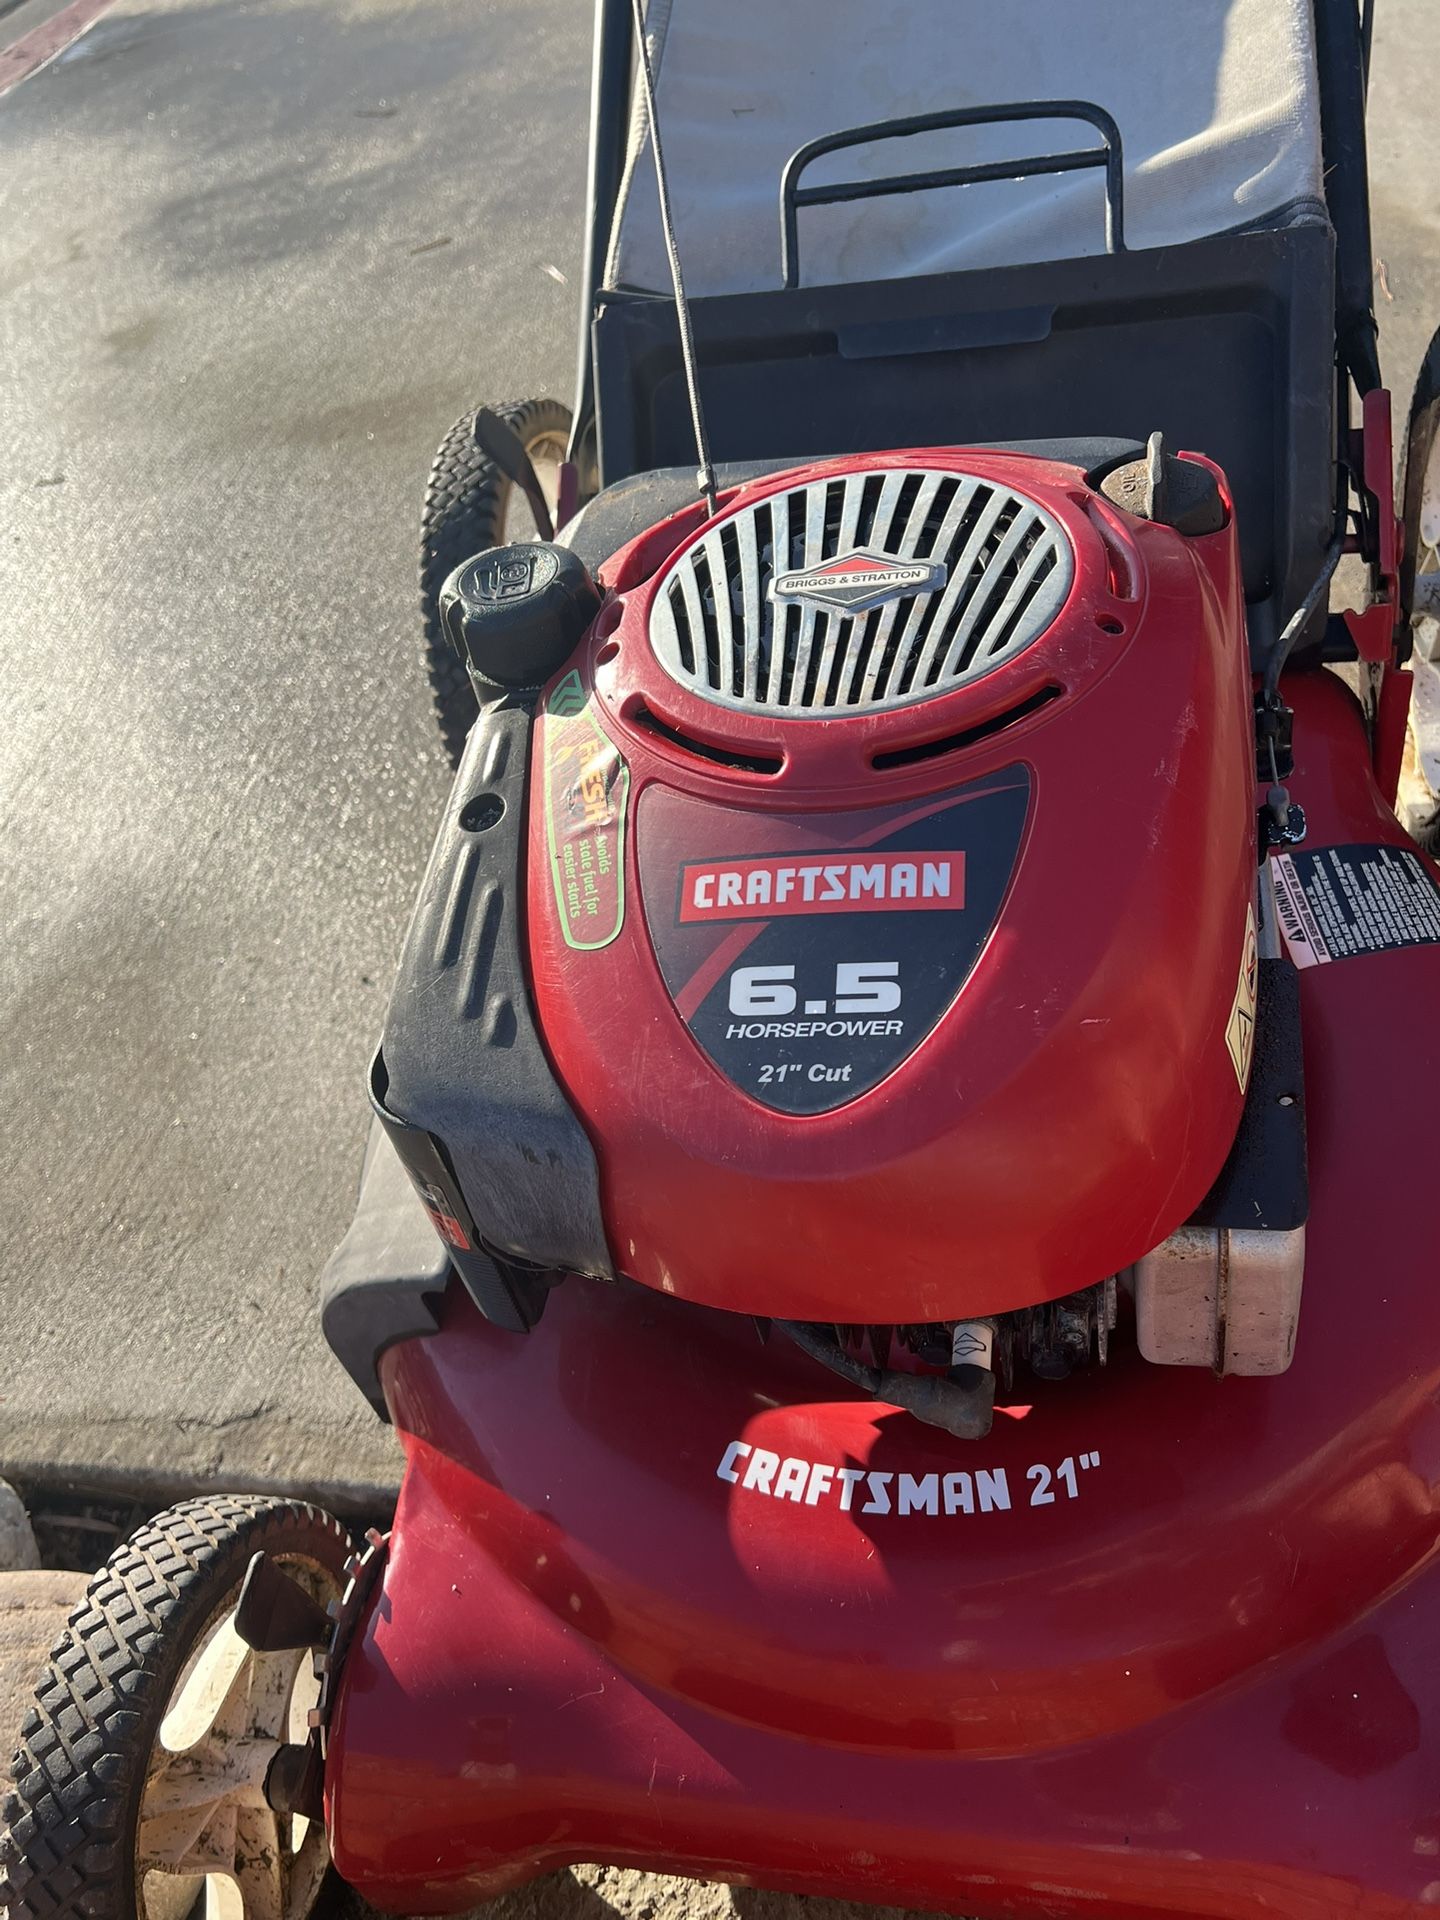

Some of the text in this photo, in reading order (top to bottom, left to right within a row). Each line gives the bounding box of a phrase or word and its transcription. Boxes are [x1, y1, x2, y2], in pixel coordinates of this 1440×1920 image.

[1121, 473, 1137, 493] OIL
[785, 570, 921, 589] BRIGGS & STRATTON
[595, 835, 611, 875] Avoids
[562, 843, 582, 918] easier starts
[579, 839, 600, 916] stale fuel for
[1281, 860, 1295, 879] DEATH
[694, 862, 952, 908] CRAFTSMAN
[1290, 880, 1298, 889] OR
[1274, 881, 1299, 929] WARNING
[1294, 890, 1307, 910] INJURY
[1302, 912, 1318, 937] SERIOUS
[1313, 937, 1325, 956] AVOID
[728, 961, 902, 1016] 6.5
[726, 1020, 904, 1040] HORSEPOWER
[758, 1063, 853, 1084] 21" Cut
[716, 1440, 1102, 1516] CRAFTSMAN 21"
